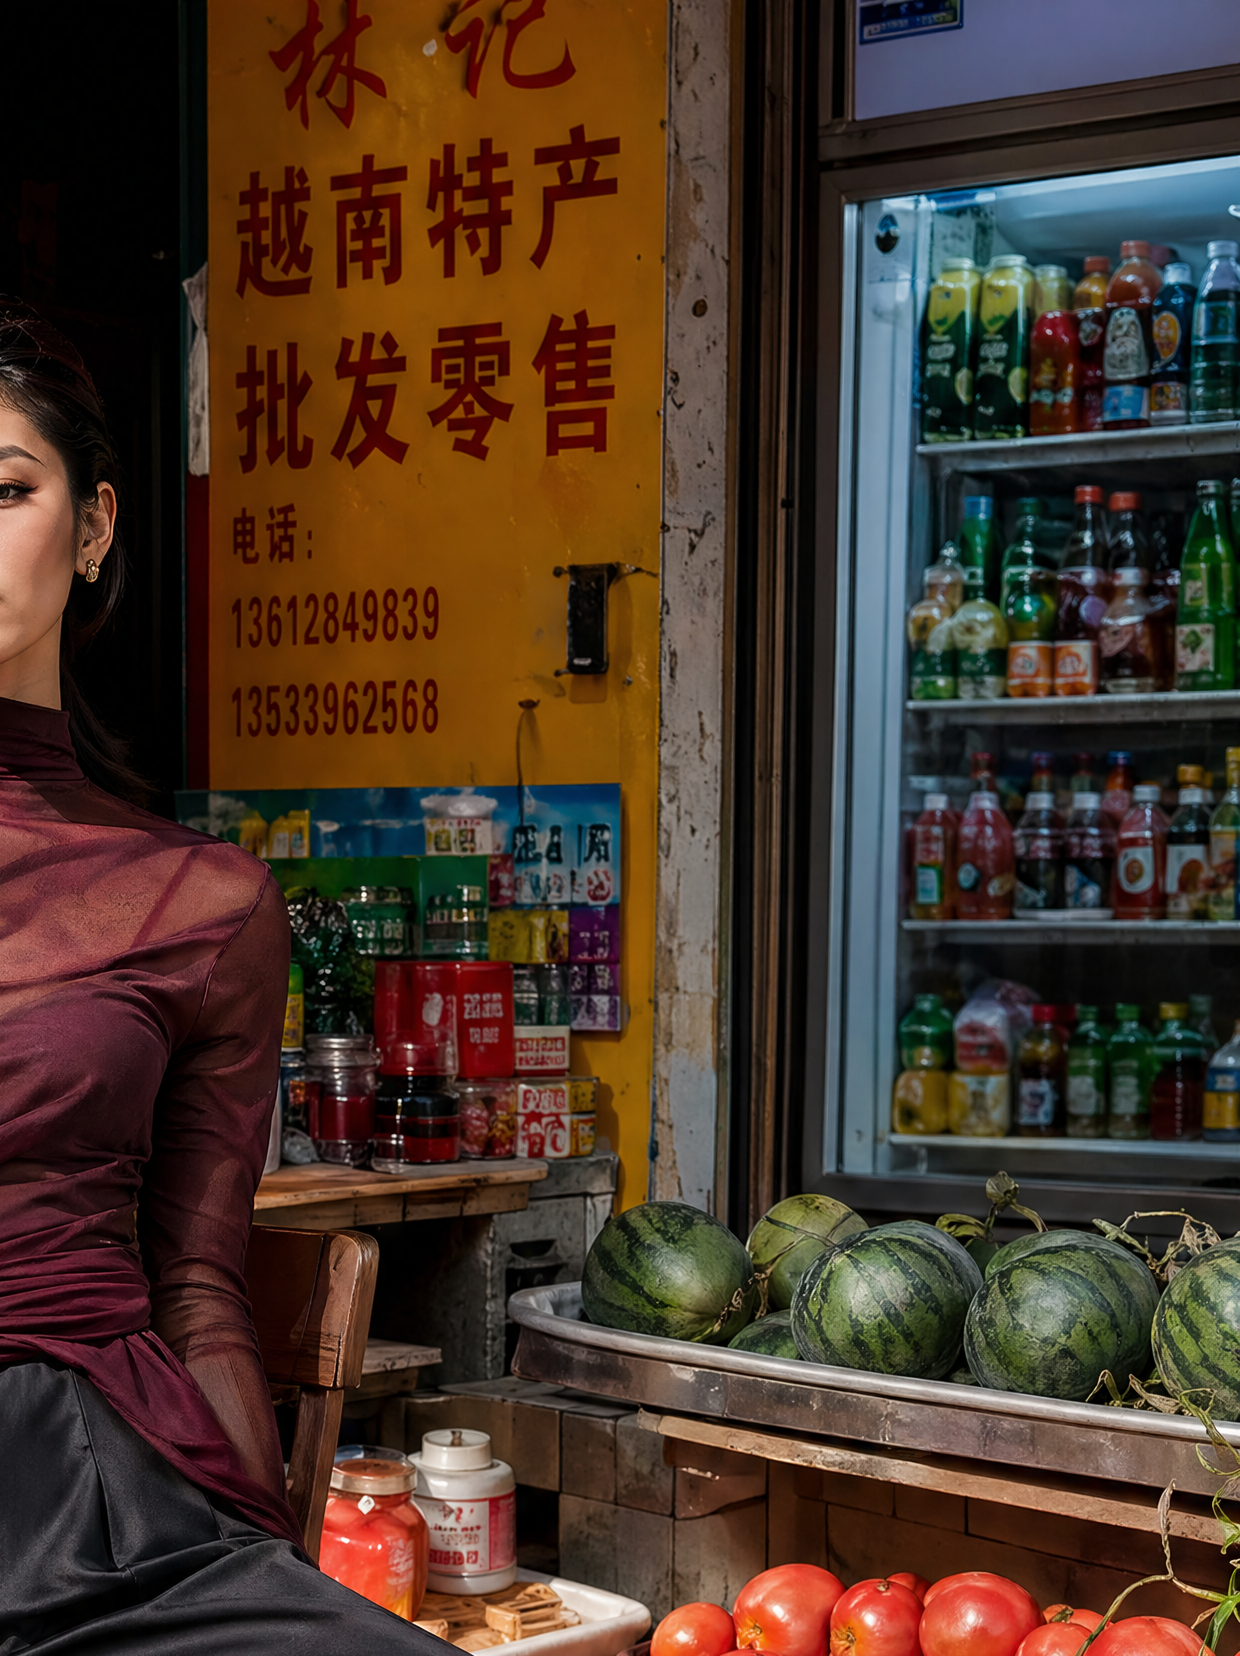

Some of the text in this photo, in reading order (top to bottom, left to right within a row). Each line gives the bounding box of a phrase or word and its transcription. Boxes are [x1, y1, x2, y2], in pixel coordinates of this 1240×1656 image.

[268, 0, 577, 131] 林记
[235, 123, 621, 300] 越南特产
[235, 309, 617, 475] 批发零售
[231, 586, 440, 649] 13612849839
[231, 678, 439, 738] 13533962568
